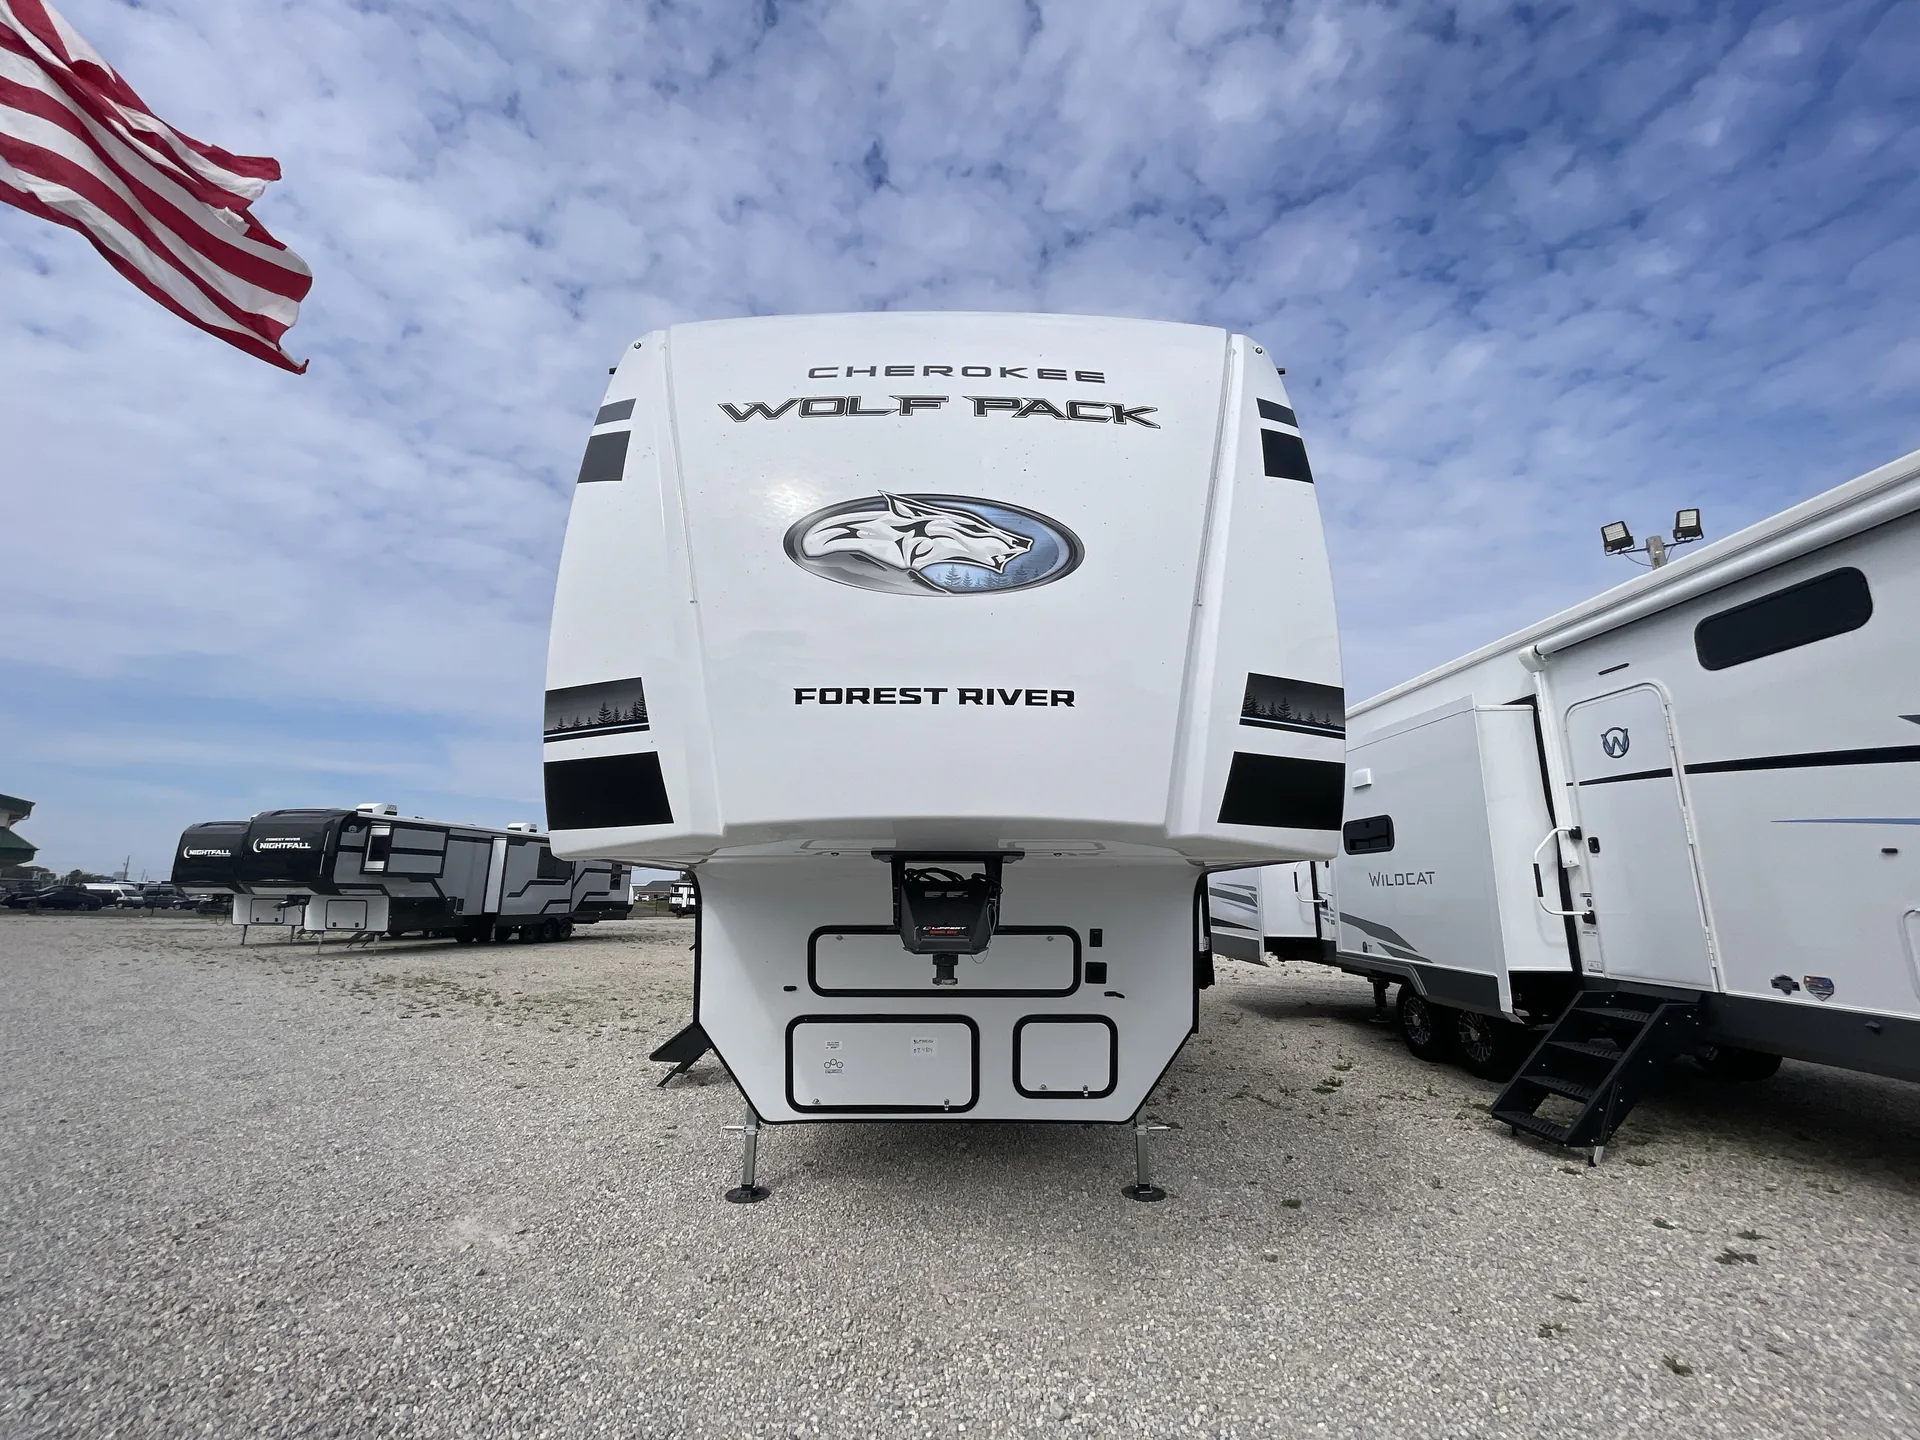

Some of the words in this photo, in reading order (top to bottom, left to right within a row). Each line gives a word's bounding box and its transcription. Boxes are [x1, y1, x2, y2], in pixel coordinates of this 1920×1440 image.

[808, 365, 1106, 384] CHEROKEE
[718, 395, 949, 423] WOLF
[962, 395, 1161, 429] PACK
[793, 687, 948, 705] FOREST
[957, 688, 1076, 707] RIVER
[1368, 871, 1435, 887] WILDCAT
